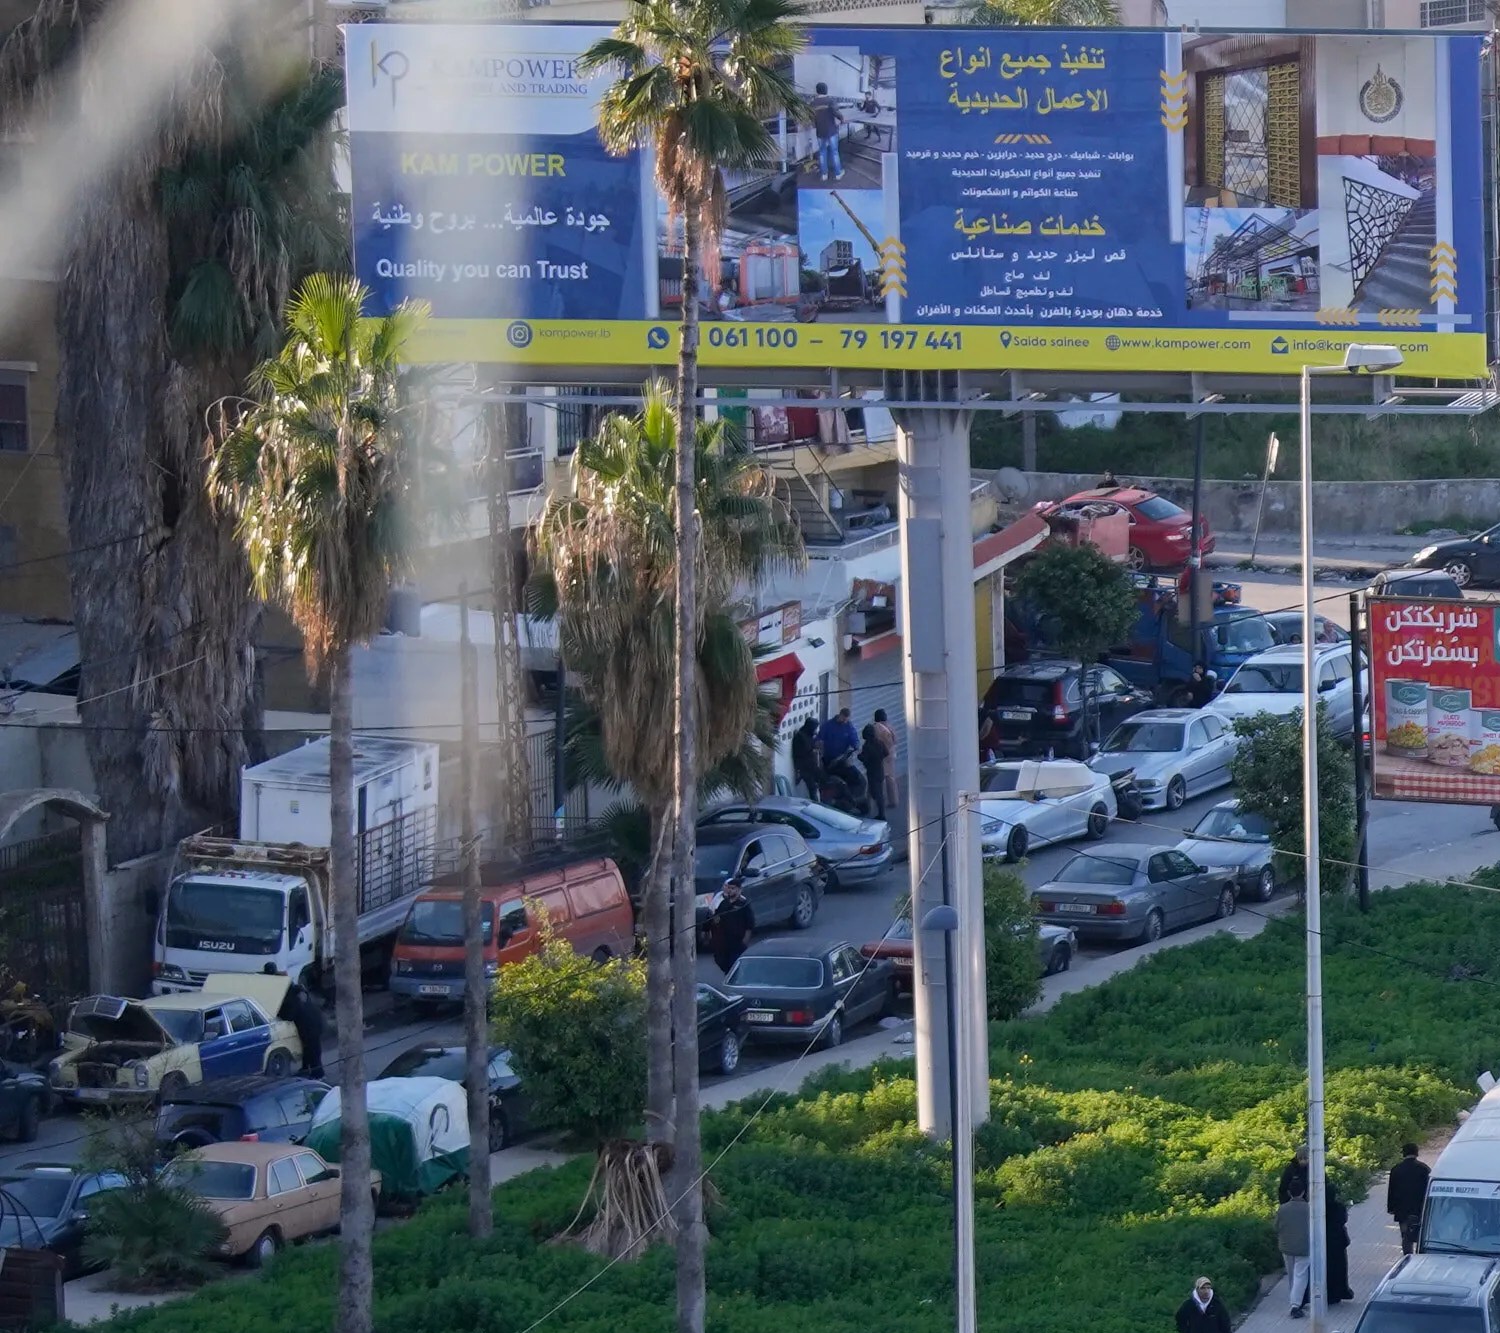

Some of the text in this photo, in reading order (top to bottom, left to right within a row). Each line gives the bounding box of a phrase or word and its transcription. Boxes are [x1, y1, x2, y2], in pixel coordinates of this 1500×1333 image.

[939, 43, 1106, 79] تنفيذ جميع انواع
[529, 83, 588, 95] TRADING
[948, 82, 1108, 114] الاعمال الحديدية
[906, 149, 1101, 162] شبابيك درج حديد خيم حديد قرميد
[400, 153, 566, 177] KAM POWER
[951, 168, 1101, 179] تنفيذ جميع أنواع الديكورات الحديدية
[1053, 187, 1078, 197] صناعة
[371, 202, 611, 234] جودة بروح وطنية
[954, 207, 1107, 240] خدمات صناعية
[951, 247, 1127, 263] قص ليزر حديد ستانلس
[376, 258, 589, 282] Quality you can Trust
[1032, 270, 1051, 280] لف
[916, 303, 1163, 318] خدمة دهان بودرة بالفرن بأحدث المكنات الأفران
[708, 327, 750, 348] 061
[755, 328, 798, 349] 100
[840, 330, 867, 350] 79
[881, 331, 918, 350] 197
[924, 331, 962, 351] 441
[1013, 335, 1048, 347] Saida
[1121, 337, 1251, 351] www.kampower.com
[1386, 605, 1478, 634] شريكتكن
[198, 940, 235, 951] ISUZU
